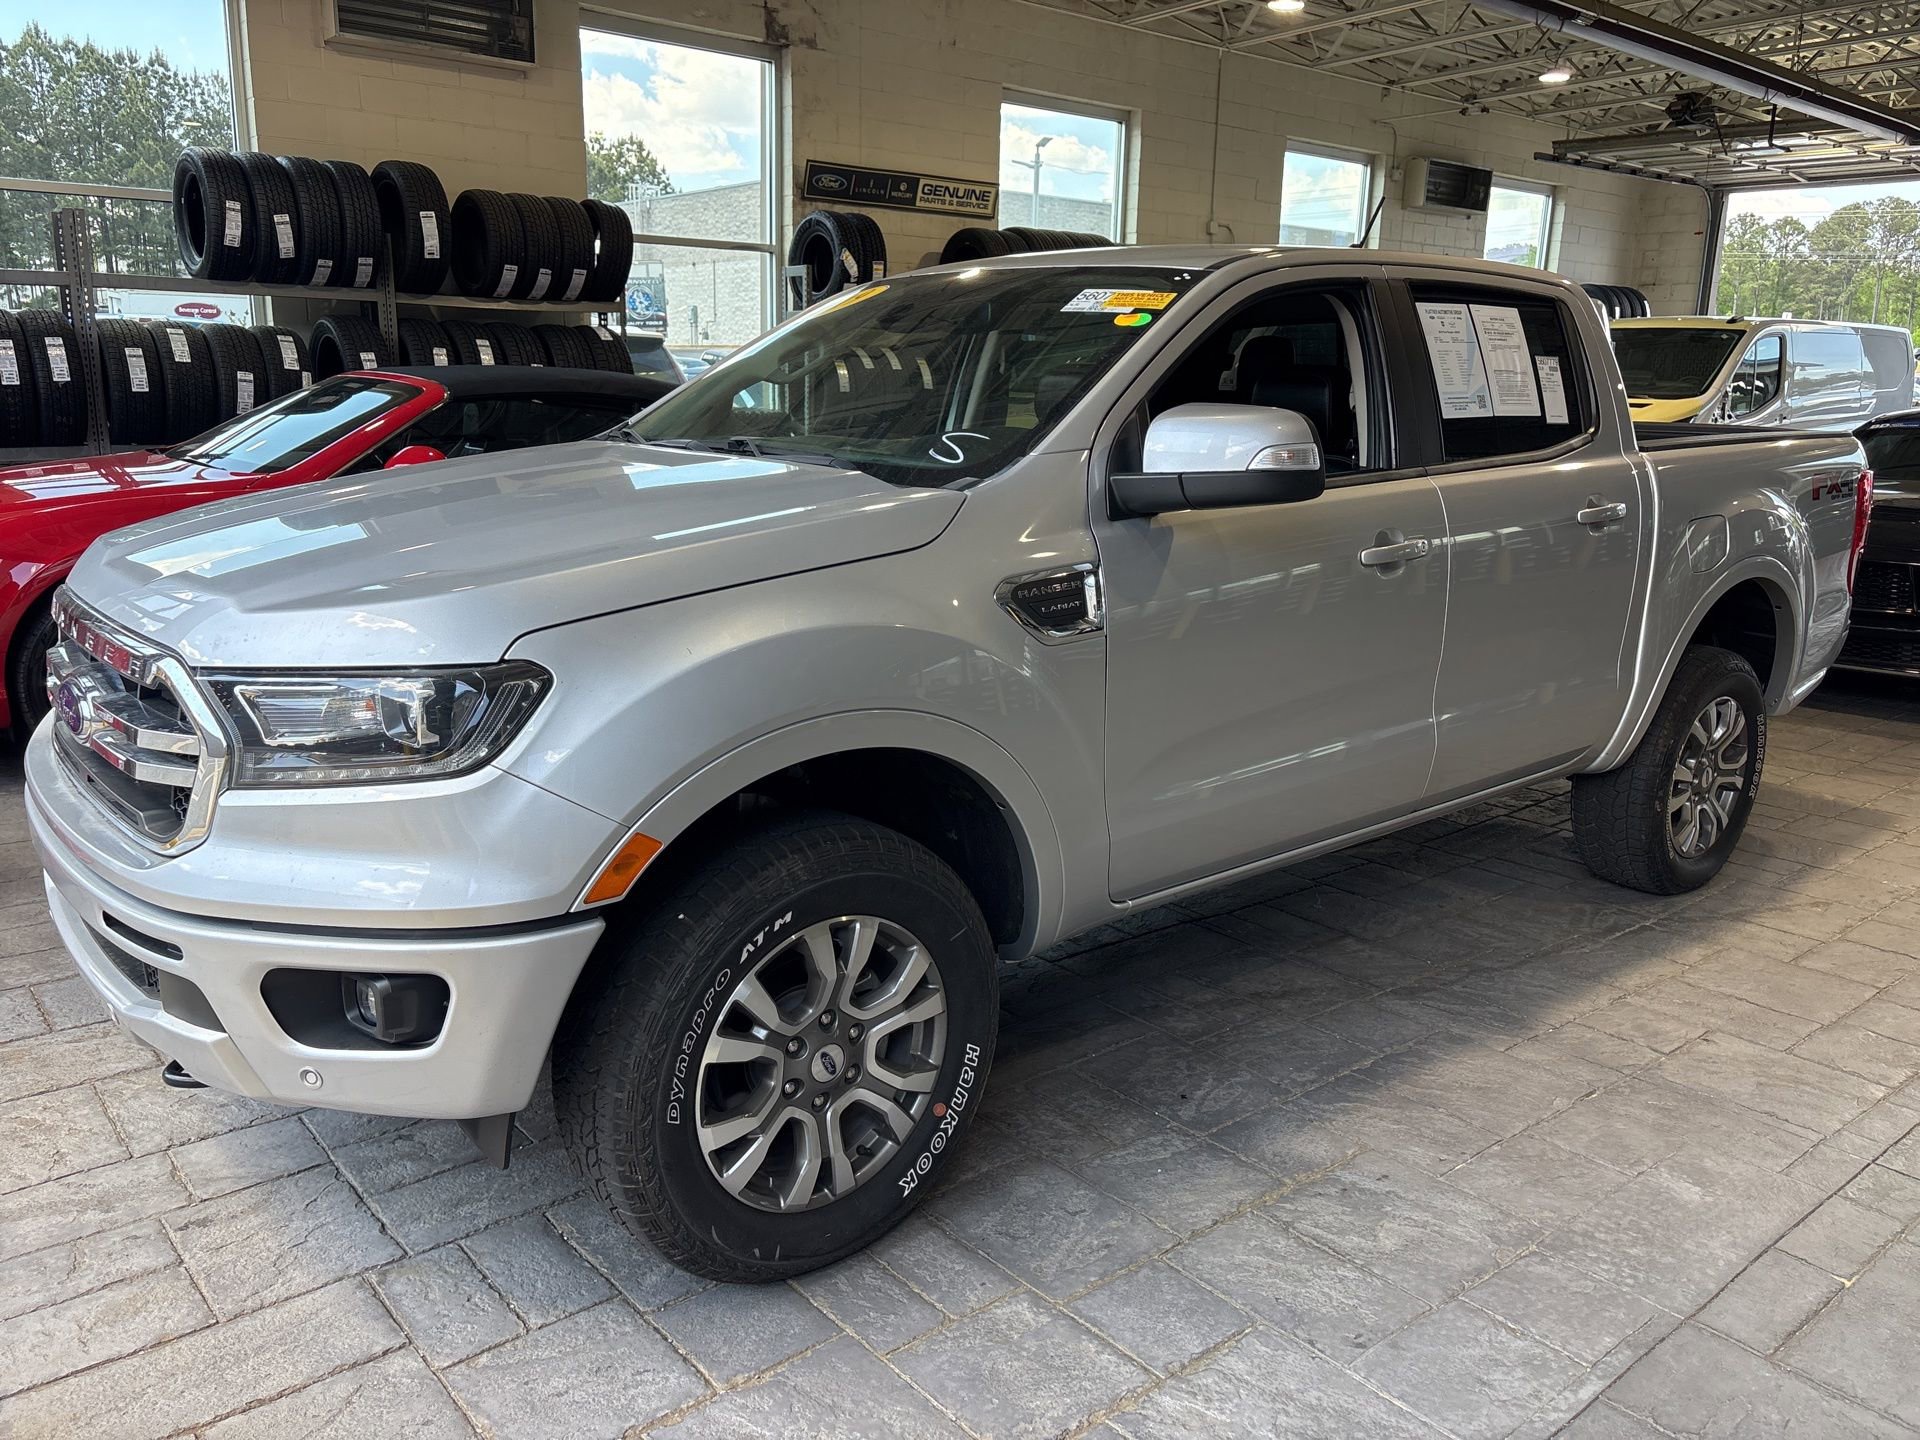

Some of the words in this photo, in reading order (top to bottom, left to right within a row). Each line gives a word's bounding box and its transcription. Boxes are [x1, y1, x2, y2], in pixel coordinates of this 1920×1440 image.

[818, 174, 841, 189] Ford
[855, 187, 885, 195] LINCOLN
[891, 191, 913, 199] MERCURY
[921, 183, 992, 202] GENUINE
[920, 196, 947, 206] PARTS
[956, 201, 989, 210] SERVICE
[1017, 580, 1082, 599] RANGER
[1041, 600, 1081, 613] LARIAT
